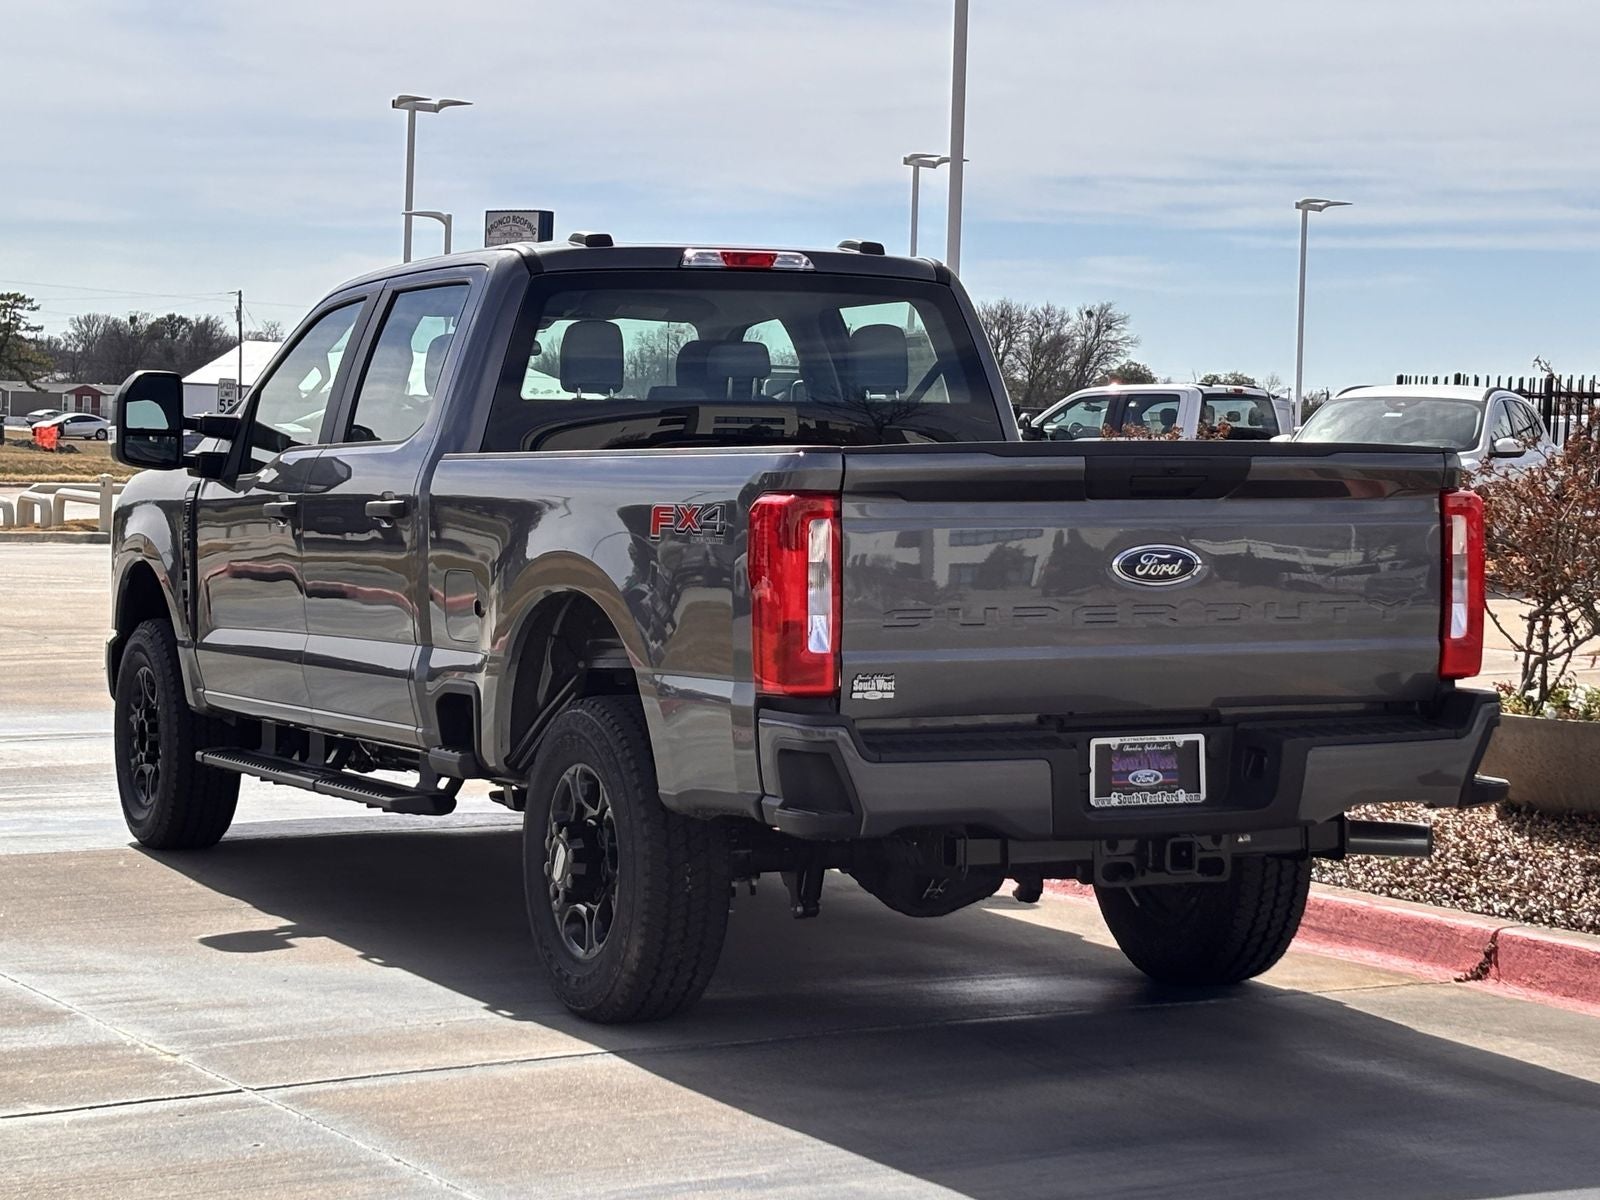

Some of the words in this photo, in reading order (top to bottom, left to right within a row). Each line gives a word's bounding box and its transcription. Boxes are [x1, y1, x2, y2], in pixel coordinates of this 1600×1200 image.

[488, 216, 511, 235] BRONCO
[512, 216, 537, 235] ROOFING
[220, 382, 235, 390] SPEED
[650, 503, 726, 541] FX4
[1135, 553, 1182, 576] Ford
[882, 604, 1178, 630] SUPER
[1205, 600, 1409, 624] DUTY
[1135, 772, 1156, 783] Ford
